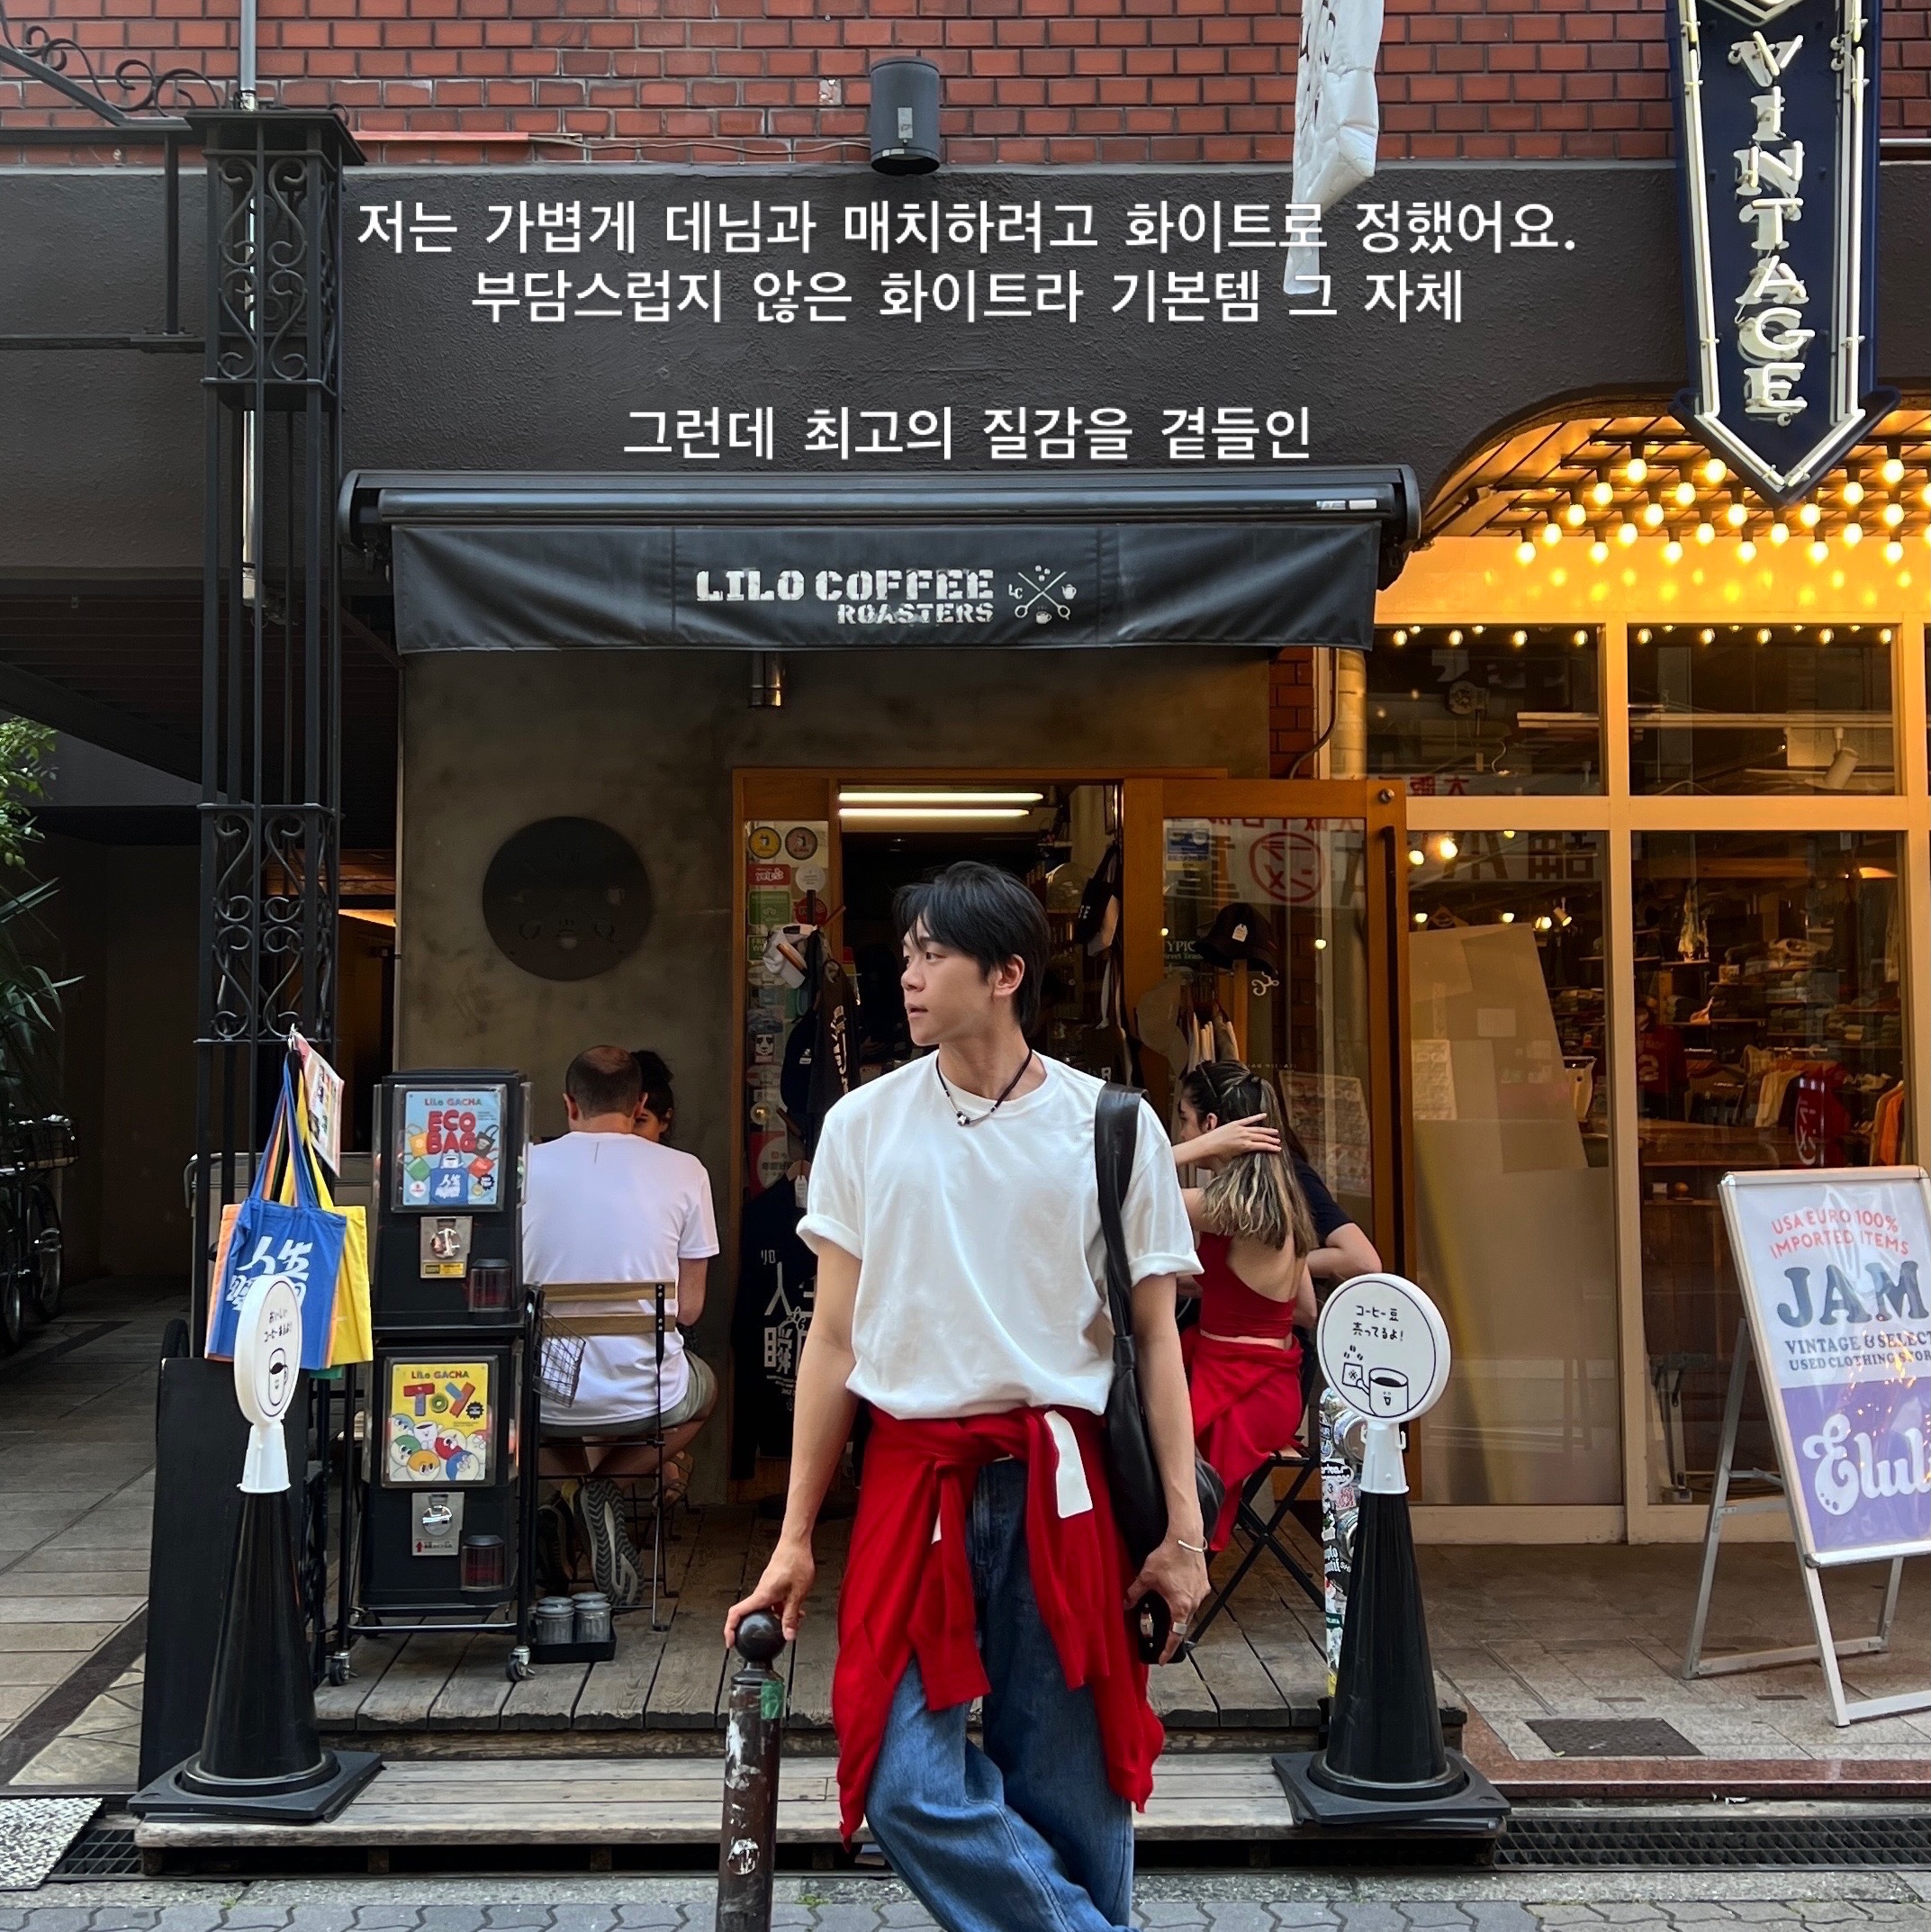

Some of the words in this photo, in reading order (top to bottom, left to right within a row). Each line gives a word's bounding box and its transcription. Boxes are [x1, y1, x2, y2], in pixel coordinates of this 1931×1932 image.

[1730, 31, 1814, 415] VINTAGE
[696, 569, 805, 601] LILO
[815, 569, 994, 601] COFFEE
[837, 603, 994, 625] ROASTERS
[429, 1109, 476, 1133] ECO
[427, 1131, 477, 1155] BAG
[1772, 1214, 1804, 1235] USA
[1806, 1208, 1852, 1225] EURO
[1855, 1210, 1899, 1233] 100%
[1770, 1229, 1854, 1259] IMPORTED
[1860, 1231, 1909, 1256] ITEMS
[1777, 1260, 1929, 1328] JAM
[1356, 1305, 1399, 1322] コーヒー豆
[1785, 1335, 1862, 1356] VINTAGE
[1789, 1359, 1827, 1372] USED
[1828, 1352, 1896, 1368] CLOTHING
[403, 1382, 475, 1418] TOY
